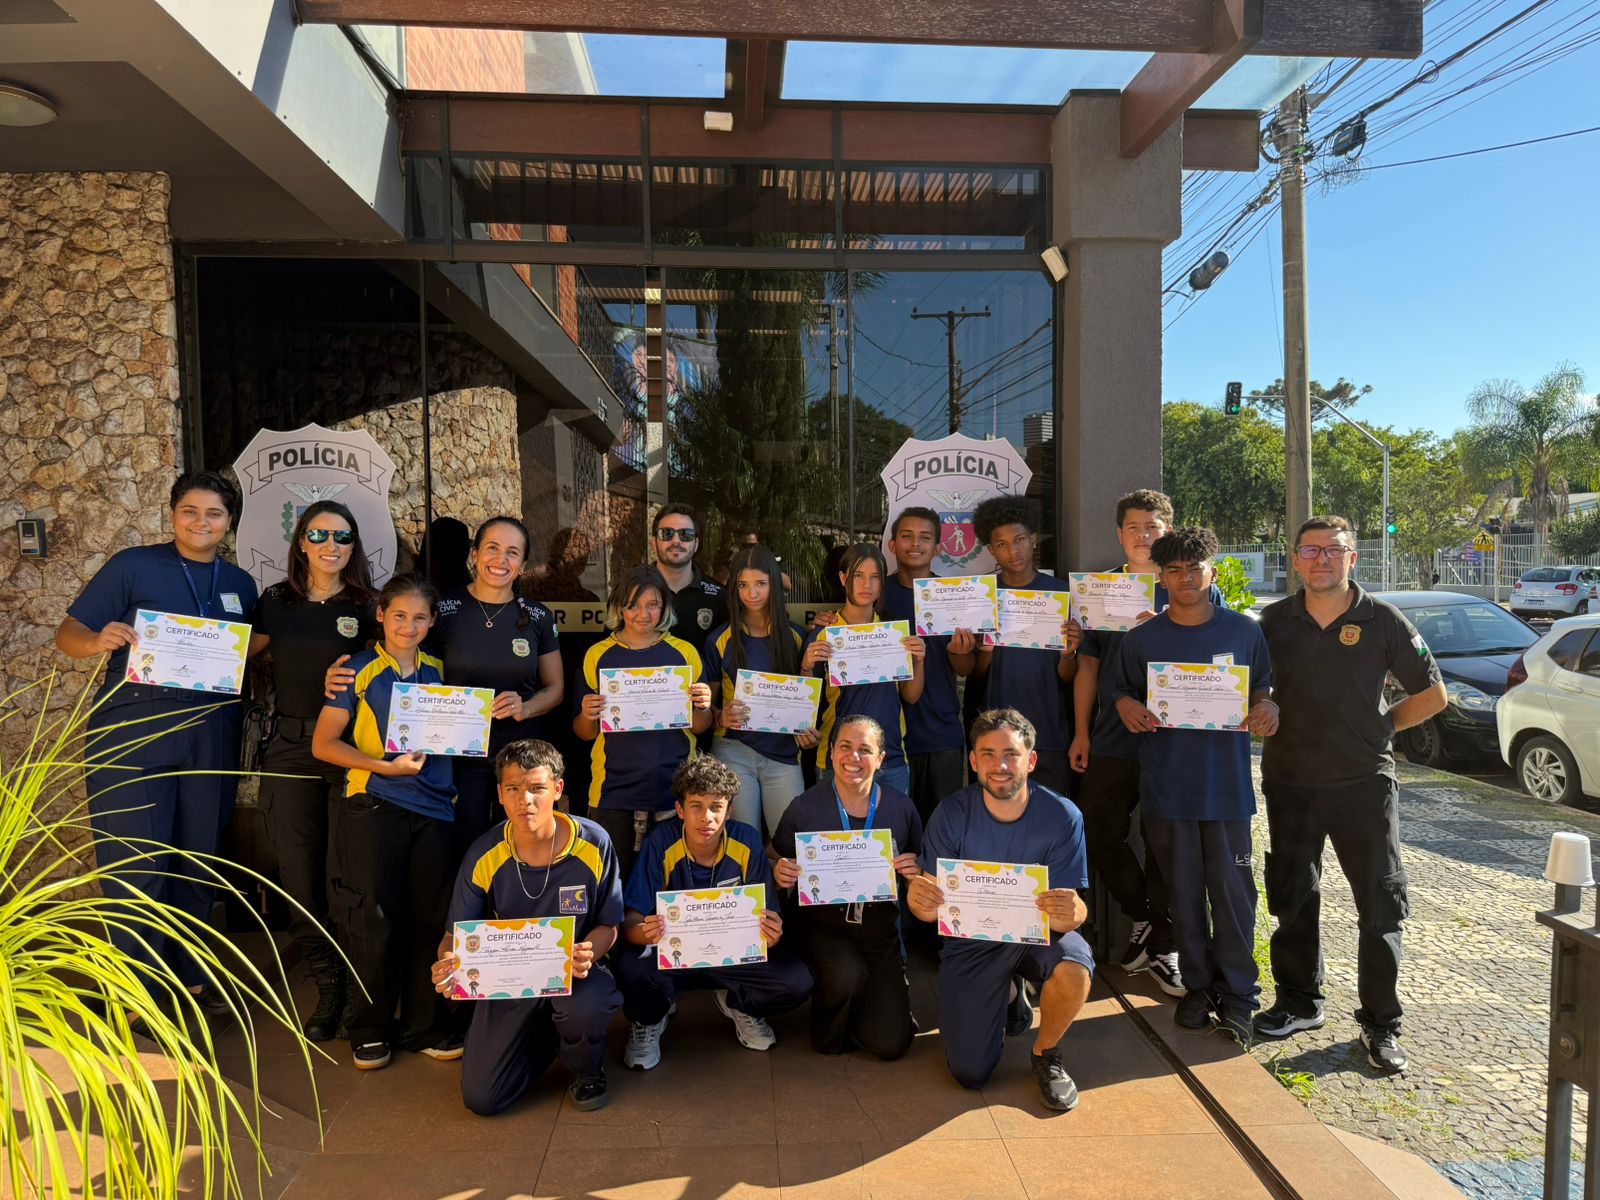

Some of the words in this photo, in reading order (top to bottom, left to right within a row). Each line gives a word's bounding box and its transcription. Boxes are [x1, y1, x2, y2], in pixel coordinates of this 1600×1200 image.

[269, 443, 360, 473] POLÍCIA
[914, 451, 999, 480] POLÍCIA
[935, 586, 975, 594] CERTIFICADO
[1092, 582, 1132, 590] CERTIFICADO
[1008, 599, 1047, 607] CERTIFICADO
[166, 626, 220, 640] CERTIFICADO
[848, 632, 888, 642] CERTIFICADO
[624, 677, 668, 686] CERTIFICADO
[1173, 674, 1222, 683] CERTIFICADO
[758, 683, 799, 693] CERTIFICADO
[417, 696, 467, 706] CERTIFICADO
[821, 842, 867, 852] CERTIFICADO
[965, 875, 1018, 886] CERTIFICADO
[685, 900, 737, 912] CERTIFICADO
[486, 931, 542, 942] CERTIFICADO
